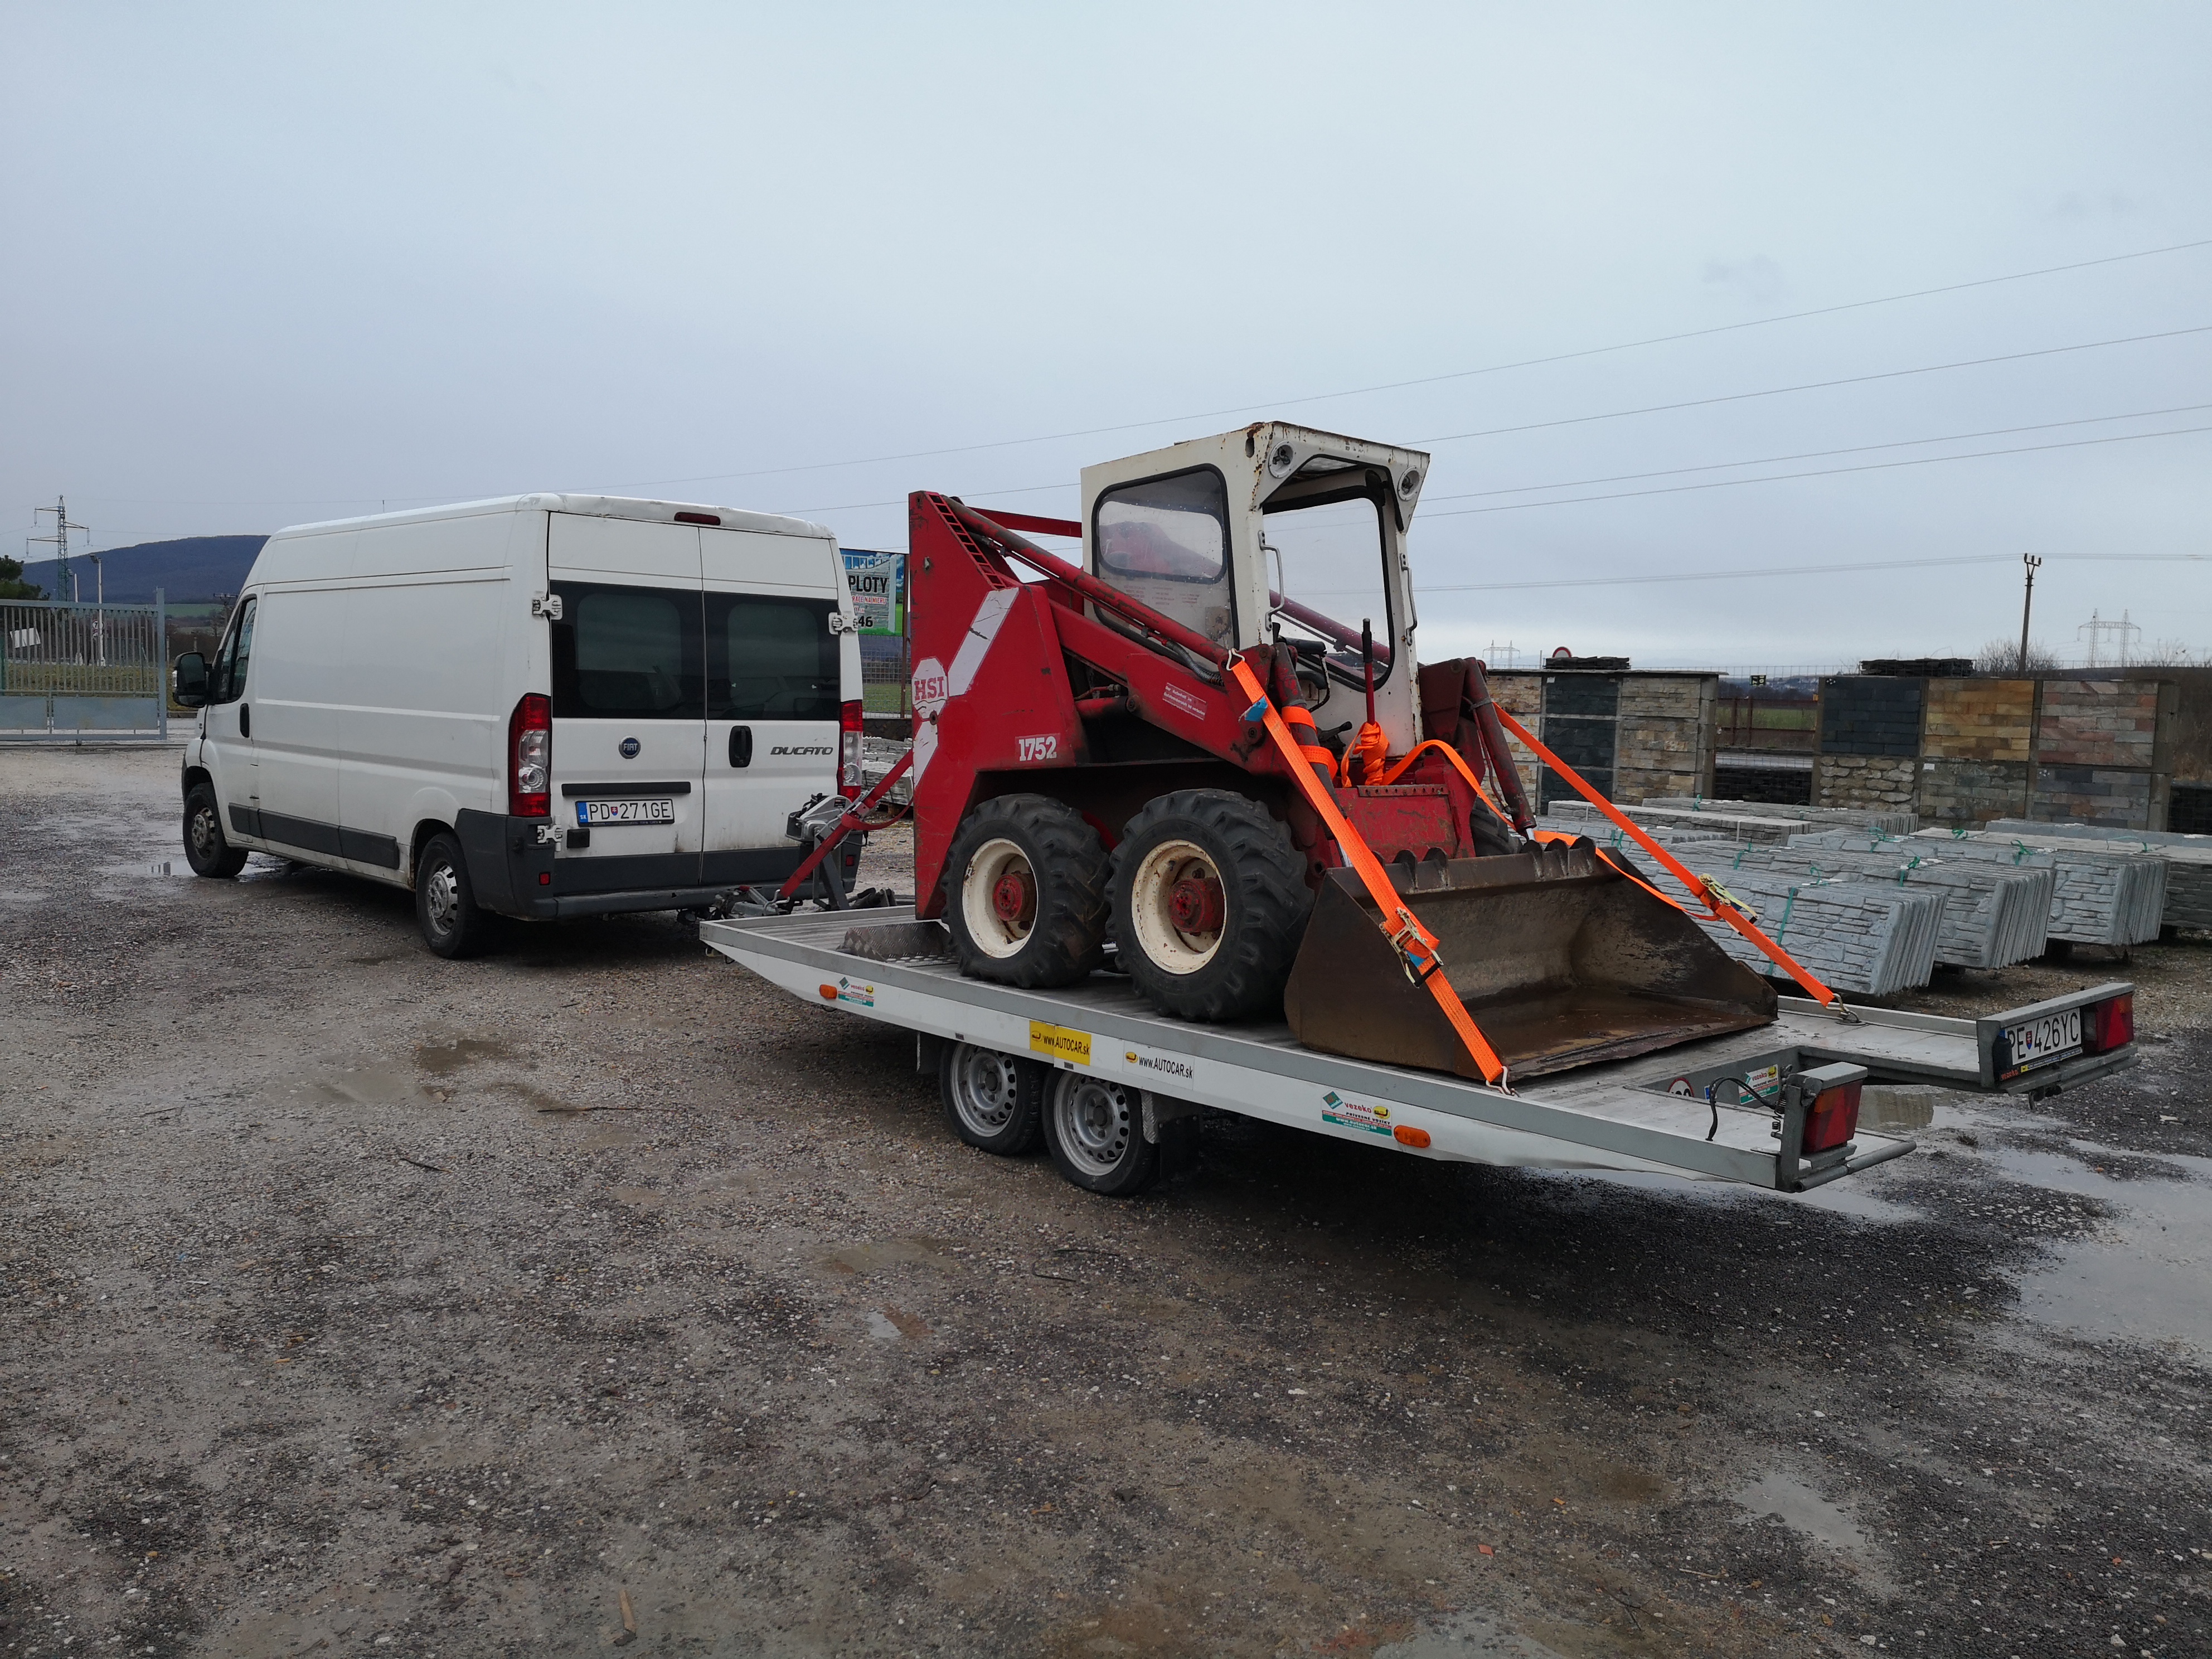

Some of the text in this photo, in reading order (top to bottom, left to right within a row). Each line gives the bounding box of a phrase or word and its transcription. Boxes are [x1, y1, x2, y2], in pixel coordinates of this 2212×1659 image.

[848, 575, 887, 593] PLOTY
[914, 676, 944, 700] HSI
[770, 746, 834, 755] DUCATO
[1018, 736, 1058, 761] 1752
[589, 802, 671, 820] PD 271GE
[2007, 1026, 2026, 1059] PE
[2034, 1012, 2079, 1053] 426YC
[1138, 1056, 1193, 1079] www.AUTOCAR.sk
[1344, 1102, 1372, 1113] vezeko
